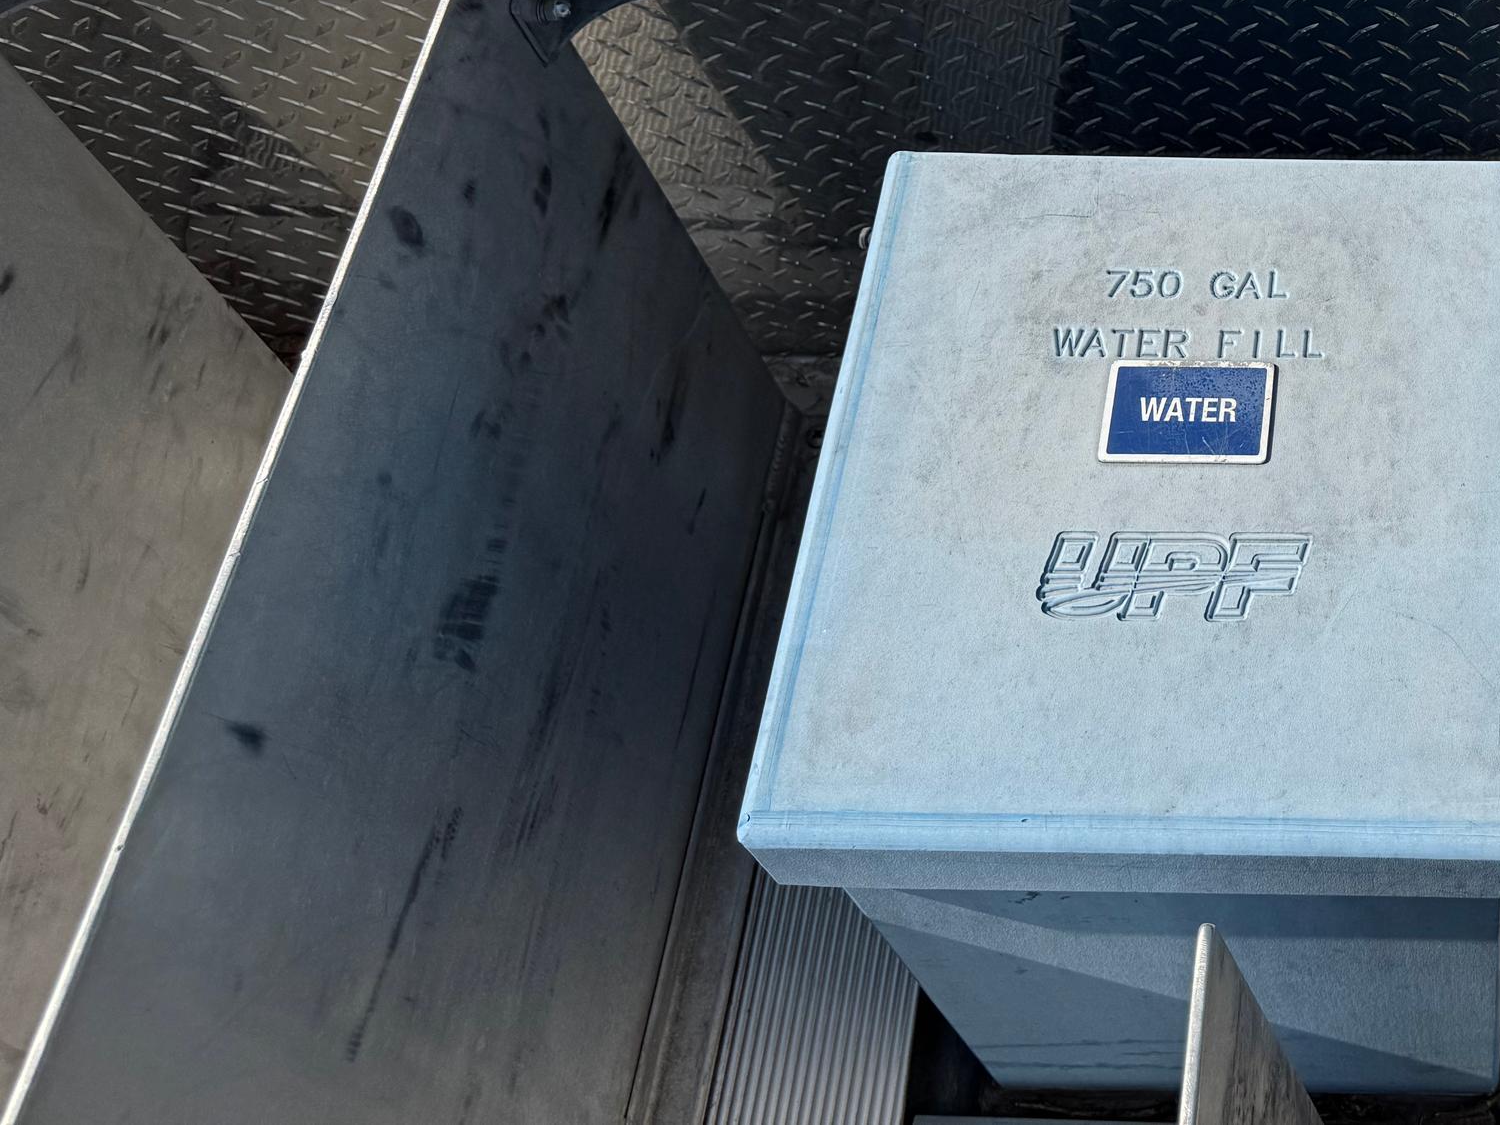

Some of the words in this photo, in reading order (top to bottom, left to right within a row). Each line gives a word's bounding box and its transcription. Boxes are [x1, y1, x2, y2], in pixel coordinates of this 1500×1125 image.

[1105, 269, 1183, 299] 750
[1210, 269, 1289, 300] GAL
[1053, 327, 1190, 359] WATER
[1217, 328, 1326, 360] FILL
[1140, 397, 1236, 423] WATER
[1036, 531, 1314, 622] UPF
